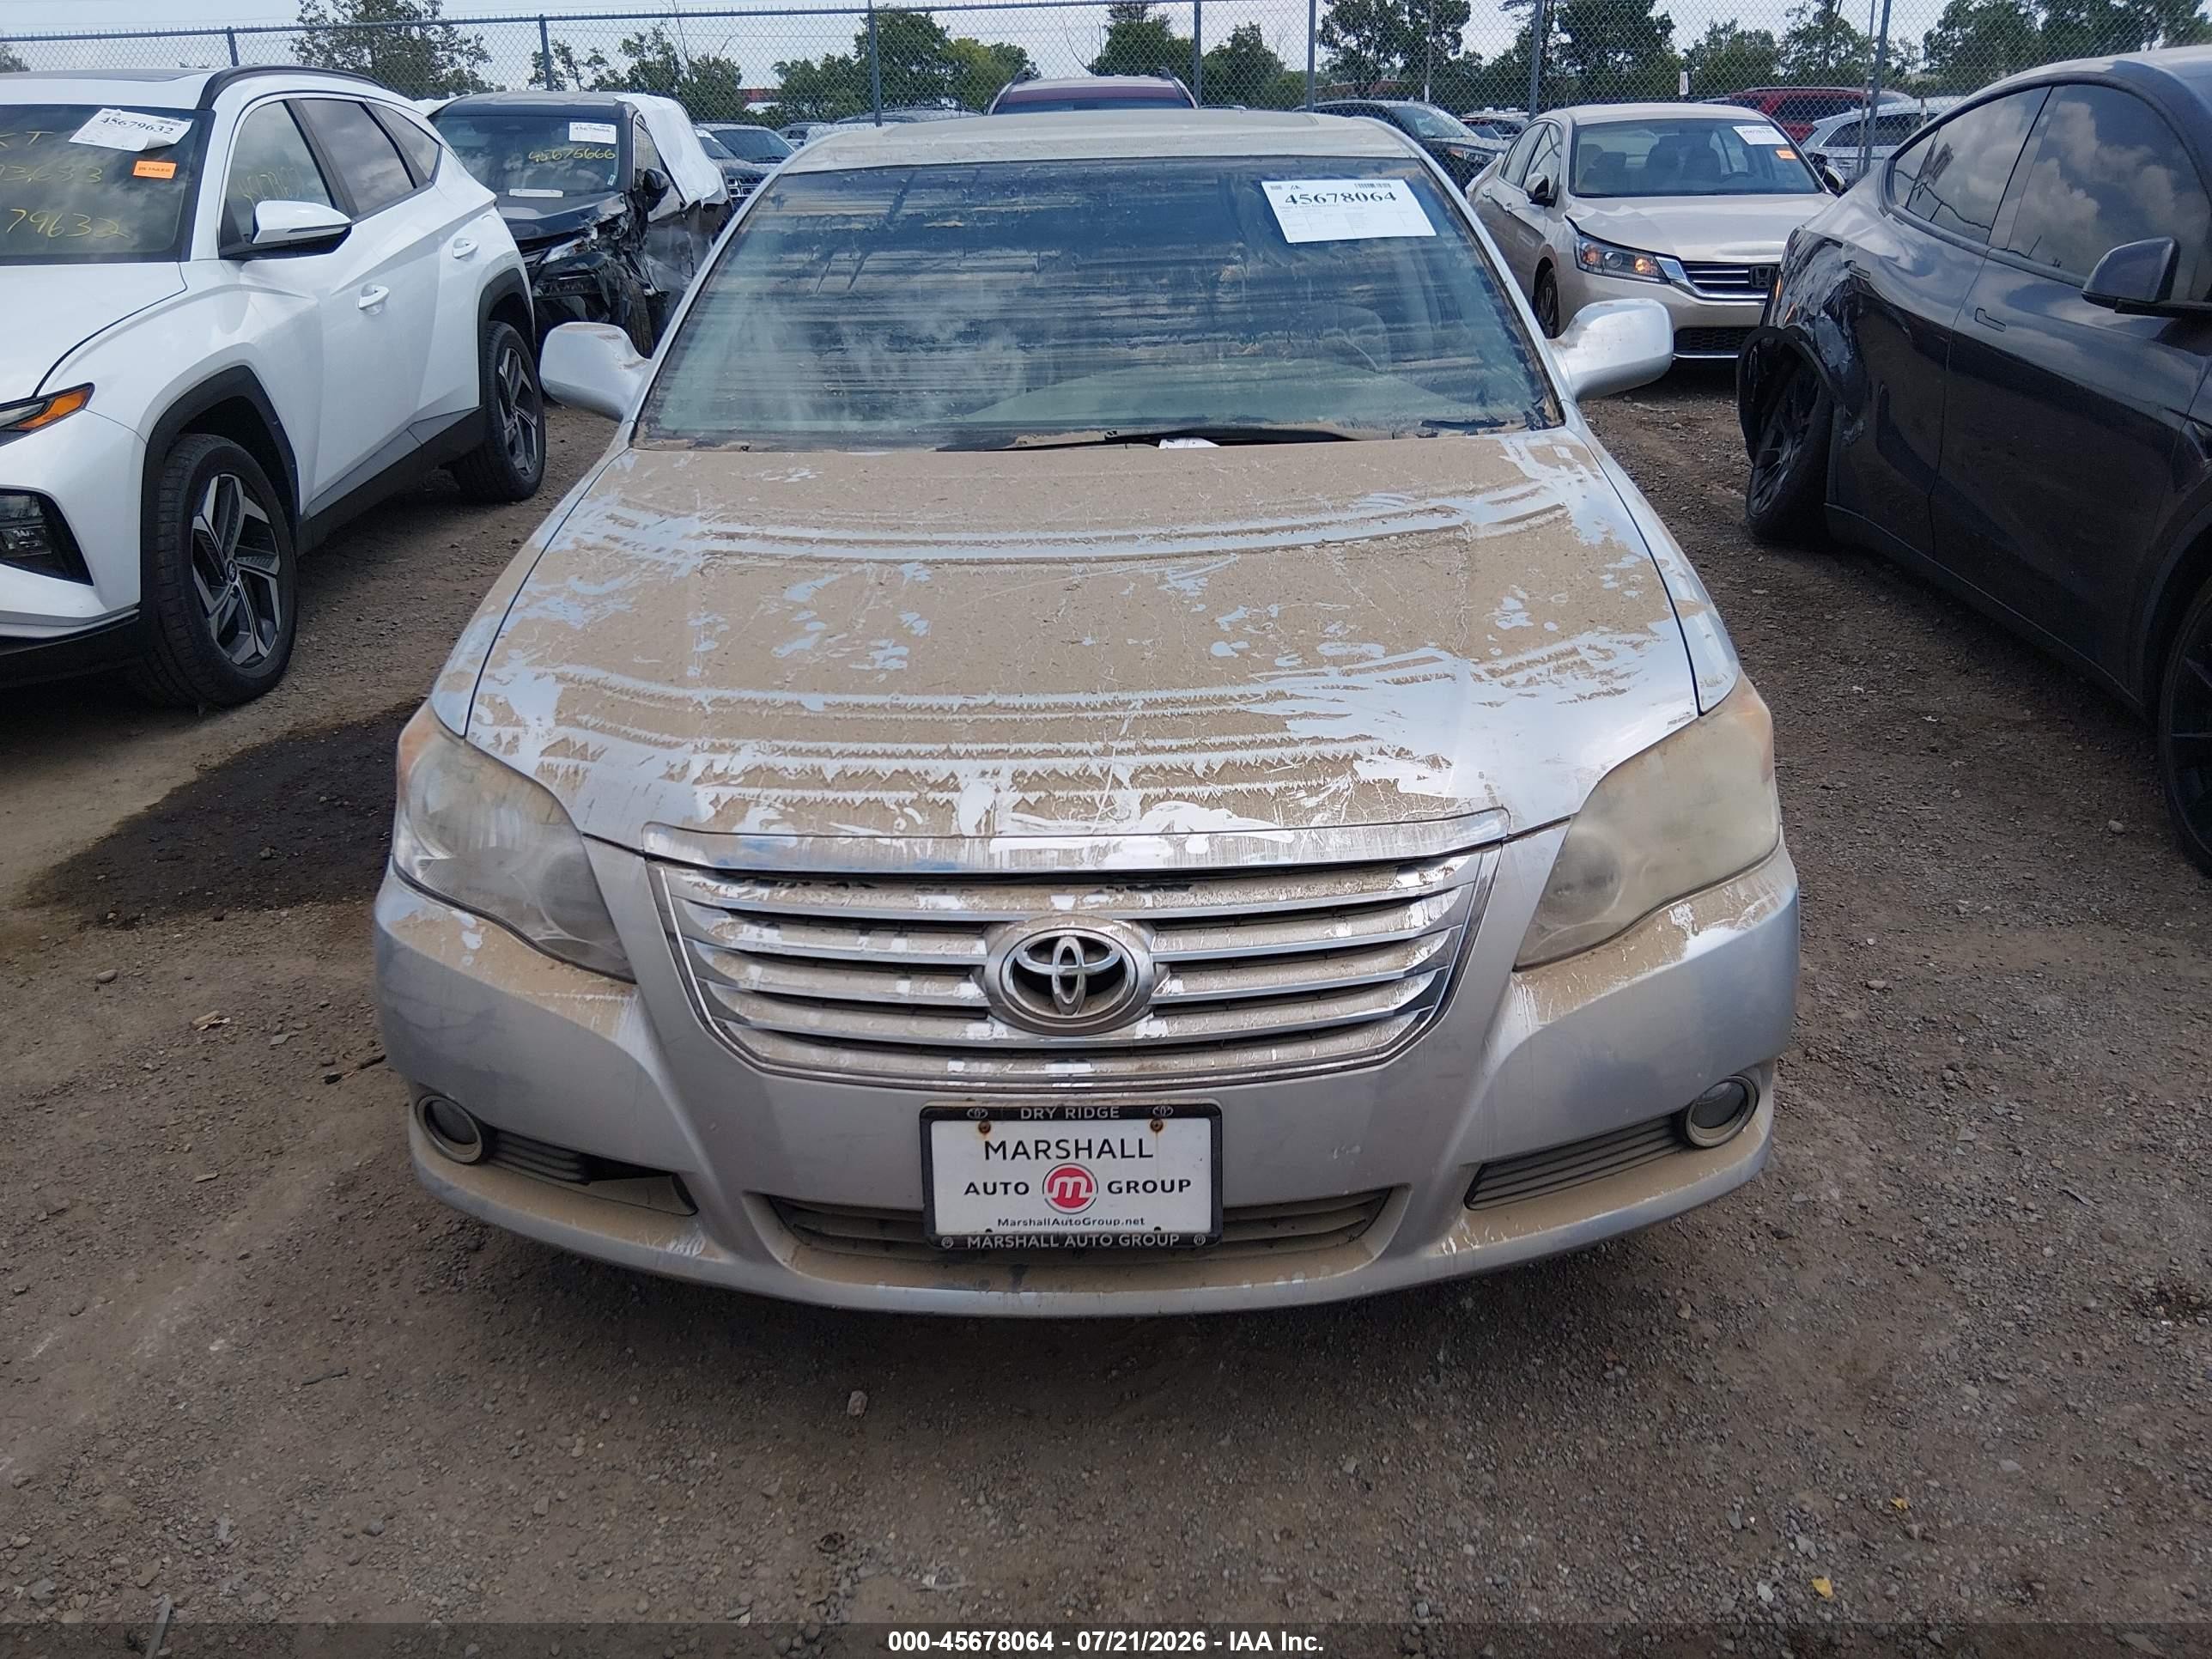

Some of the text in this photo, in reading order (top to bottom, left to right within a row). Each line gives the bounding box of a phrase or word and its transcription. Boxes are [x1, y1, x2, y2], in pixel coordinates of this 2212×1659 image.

[528, 148, 616, 162] 45675666
[1285, 191, 1397, 205] 45678064
[1020, 1106, 1120, 1120] DRY RIDGE
[984, 1138, 1154, 1161] MARSHALL
[963, 1182, 1030, 1195] AUTO
[1107, 1179, 1192, 1194] GROUP
[997, 1217, 1146, 1227] MarshallAutoGroup.net
[967, 1235, 1060, 1249] MARSHALL
[1065, 1234, 1113, 1248] AUTO
[1118, 1232, 1180, 1247] GROUP
